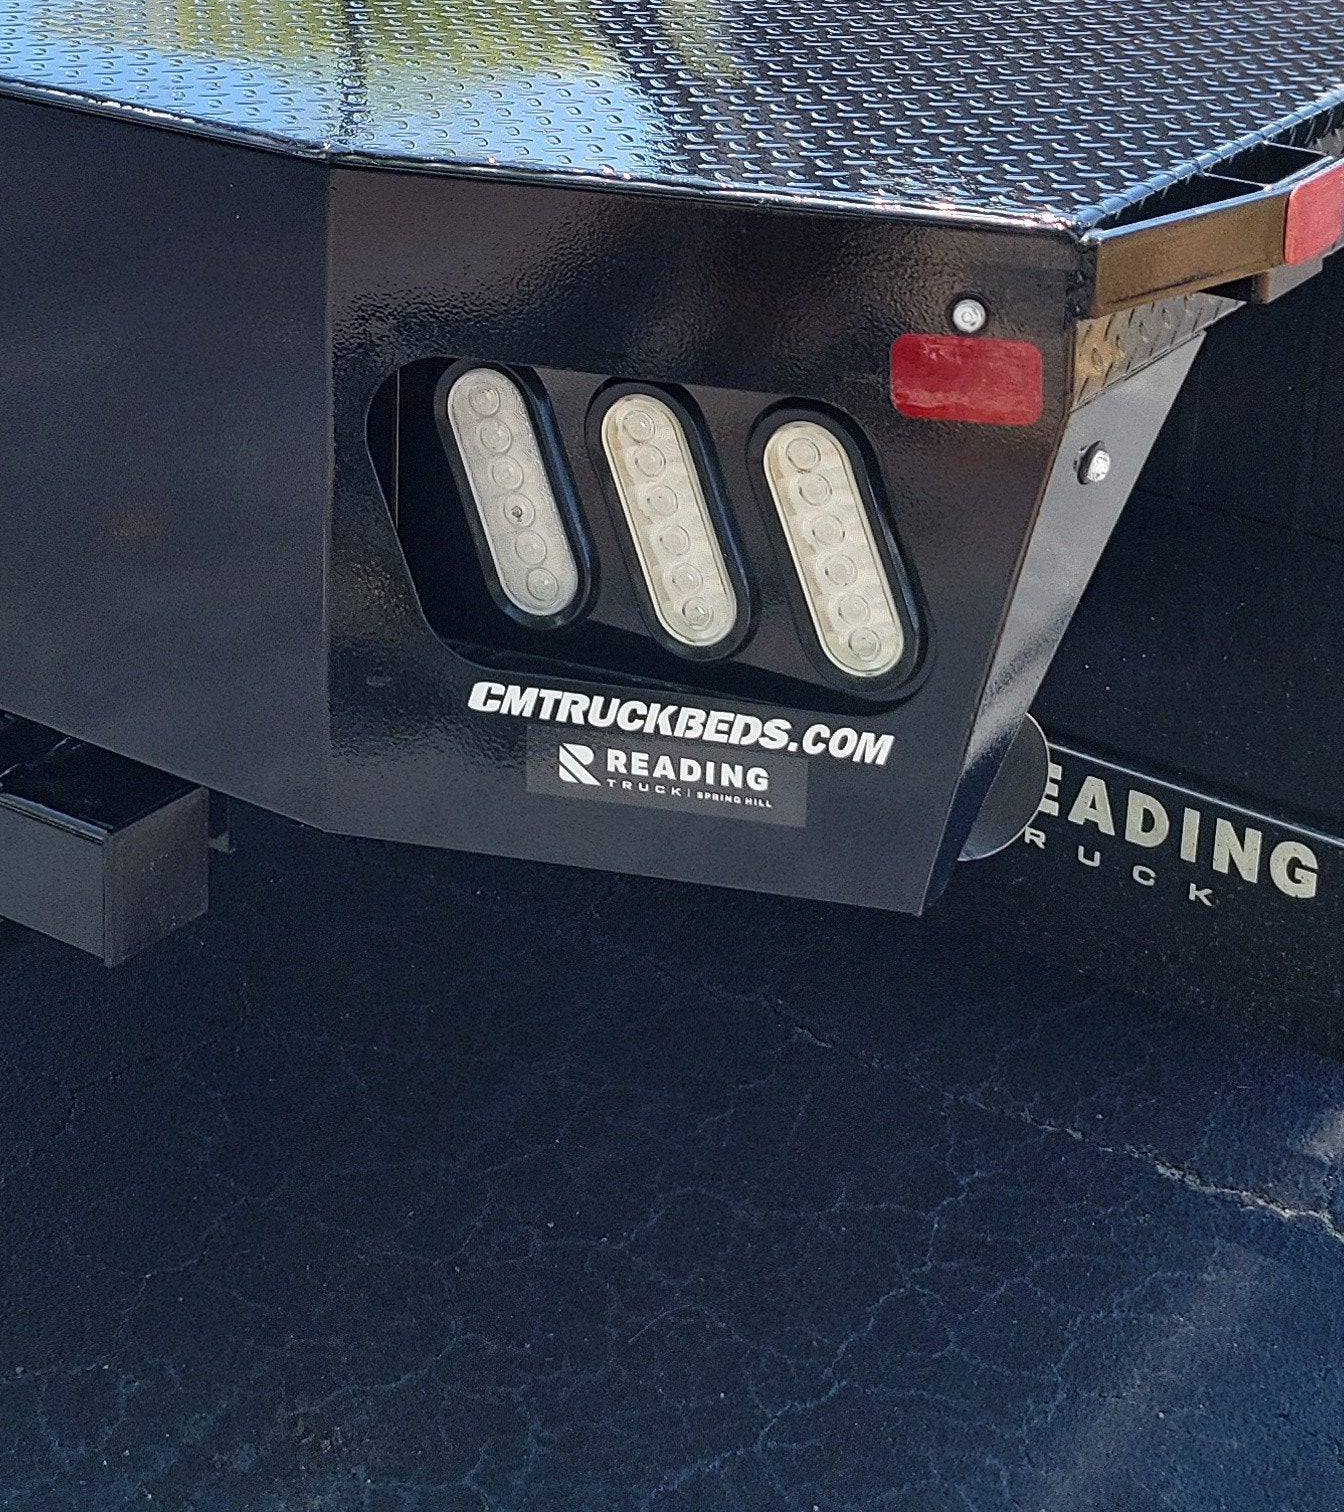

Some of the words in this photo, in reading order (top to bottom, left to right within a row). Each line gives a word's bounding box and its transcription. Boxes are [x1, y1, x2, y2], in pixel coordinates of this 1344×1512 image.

[466, 680, 895, 767] CMTRUCKBEDS.COM
[606, 747, 770, 792] READING
[606, 778, 682, 797] TRUCK
[696, 791, 741, 804] SPRING
[744, 798, 772, 808] HILL
[1023, 826, 1213, 907] RUCK
[1037, 763, 1319, 900] EADING
